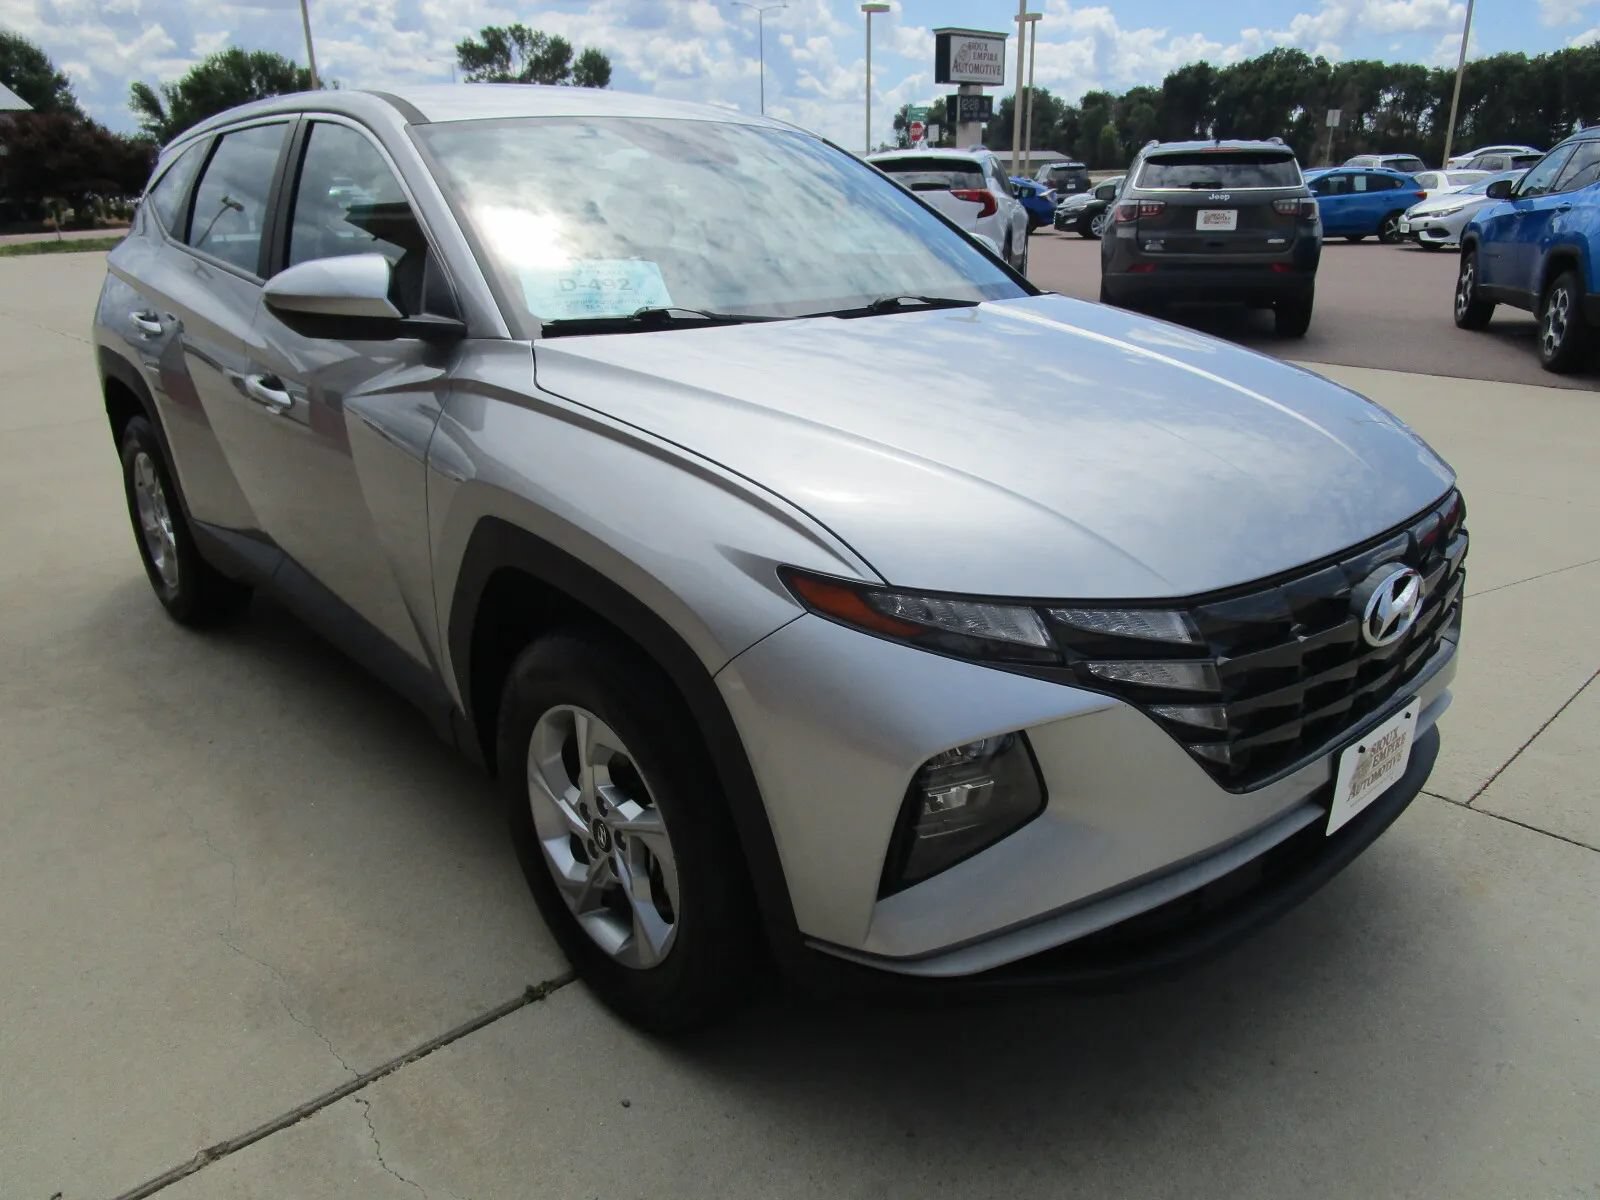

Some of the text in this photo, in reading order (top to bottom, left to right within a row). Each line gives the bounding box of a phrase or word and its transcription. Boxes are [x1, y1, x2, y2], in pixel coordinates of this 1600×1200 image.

[968, 41, 988, 52] SIOUX
[972, 52, 998, 61] EMPIRE
[952, 60, 1001, 76] AUTOMOTIVE
[910, 127, 922, 136] STOP
[1208, 192, 1231, 201] Jeep
[1370, 727, 1399, 753] SIOUX
[1372, 732, 1406, 767] EMPIRE
[1347, 752, 1402, 801] AUTOMOTIVE
